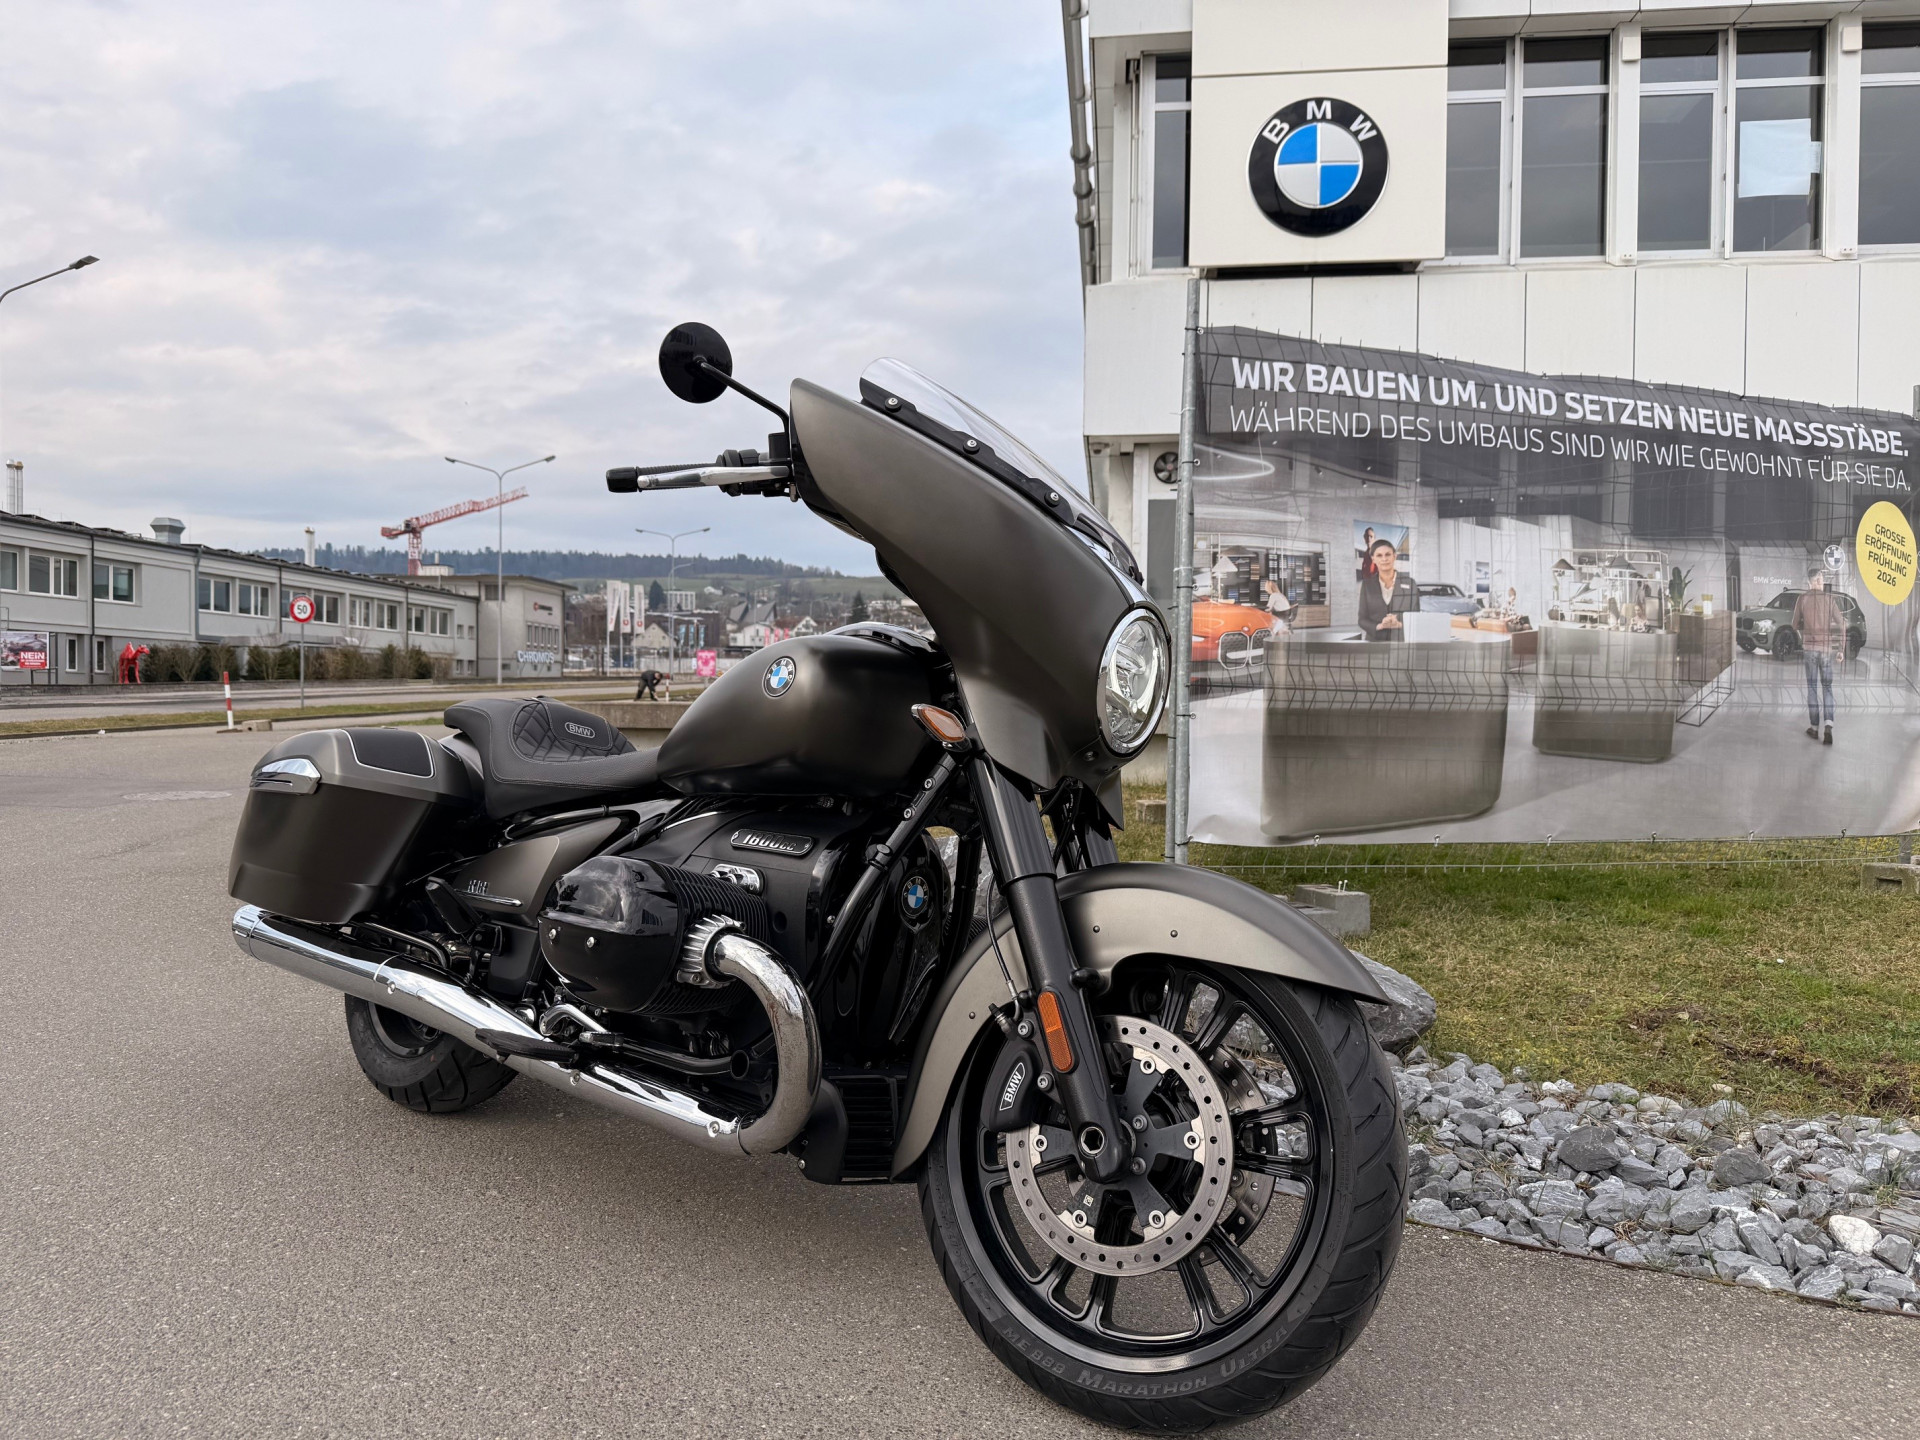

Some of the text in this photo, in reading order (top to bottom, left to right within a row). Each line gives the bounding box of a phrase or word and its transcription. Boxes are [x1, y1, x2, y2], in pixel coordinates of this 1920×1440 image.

[1261, 99, 1378, 144] BMW
[1231, 357, 1909, 457] WIR BAUEN UM. UND SETZEN NEUE MASSSTÄBE.
[1230, 401, 1912, 491] WÄHREND DES UMBAUS SIND WIR WIE GEWOHNT FÜR SIE DA.
[1875, 523, 1906, 547] GROSSE
[1865, 534, 1912, 565] ERÖFFNUNG
[1868, 550, 1907, 577] FRÜHLING
[1753, 576, 1792, 586] BMW Service
[1877, 569, 1897, 587] 2026
[296, 604, 308, 615] 50
[20, 651, 46, 660] NEIN
[517, 650, 555, 664] CHROMOS
[569, 724, 591, 736] BMW
[742, 832, 797, 851] 1800cc
[1004, 1070, 1022, 1103] BMW
[1003, 1327, 1032, 1351] ME
[1030, 1350, 1067, 1375] 888
